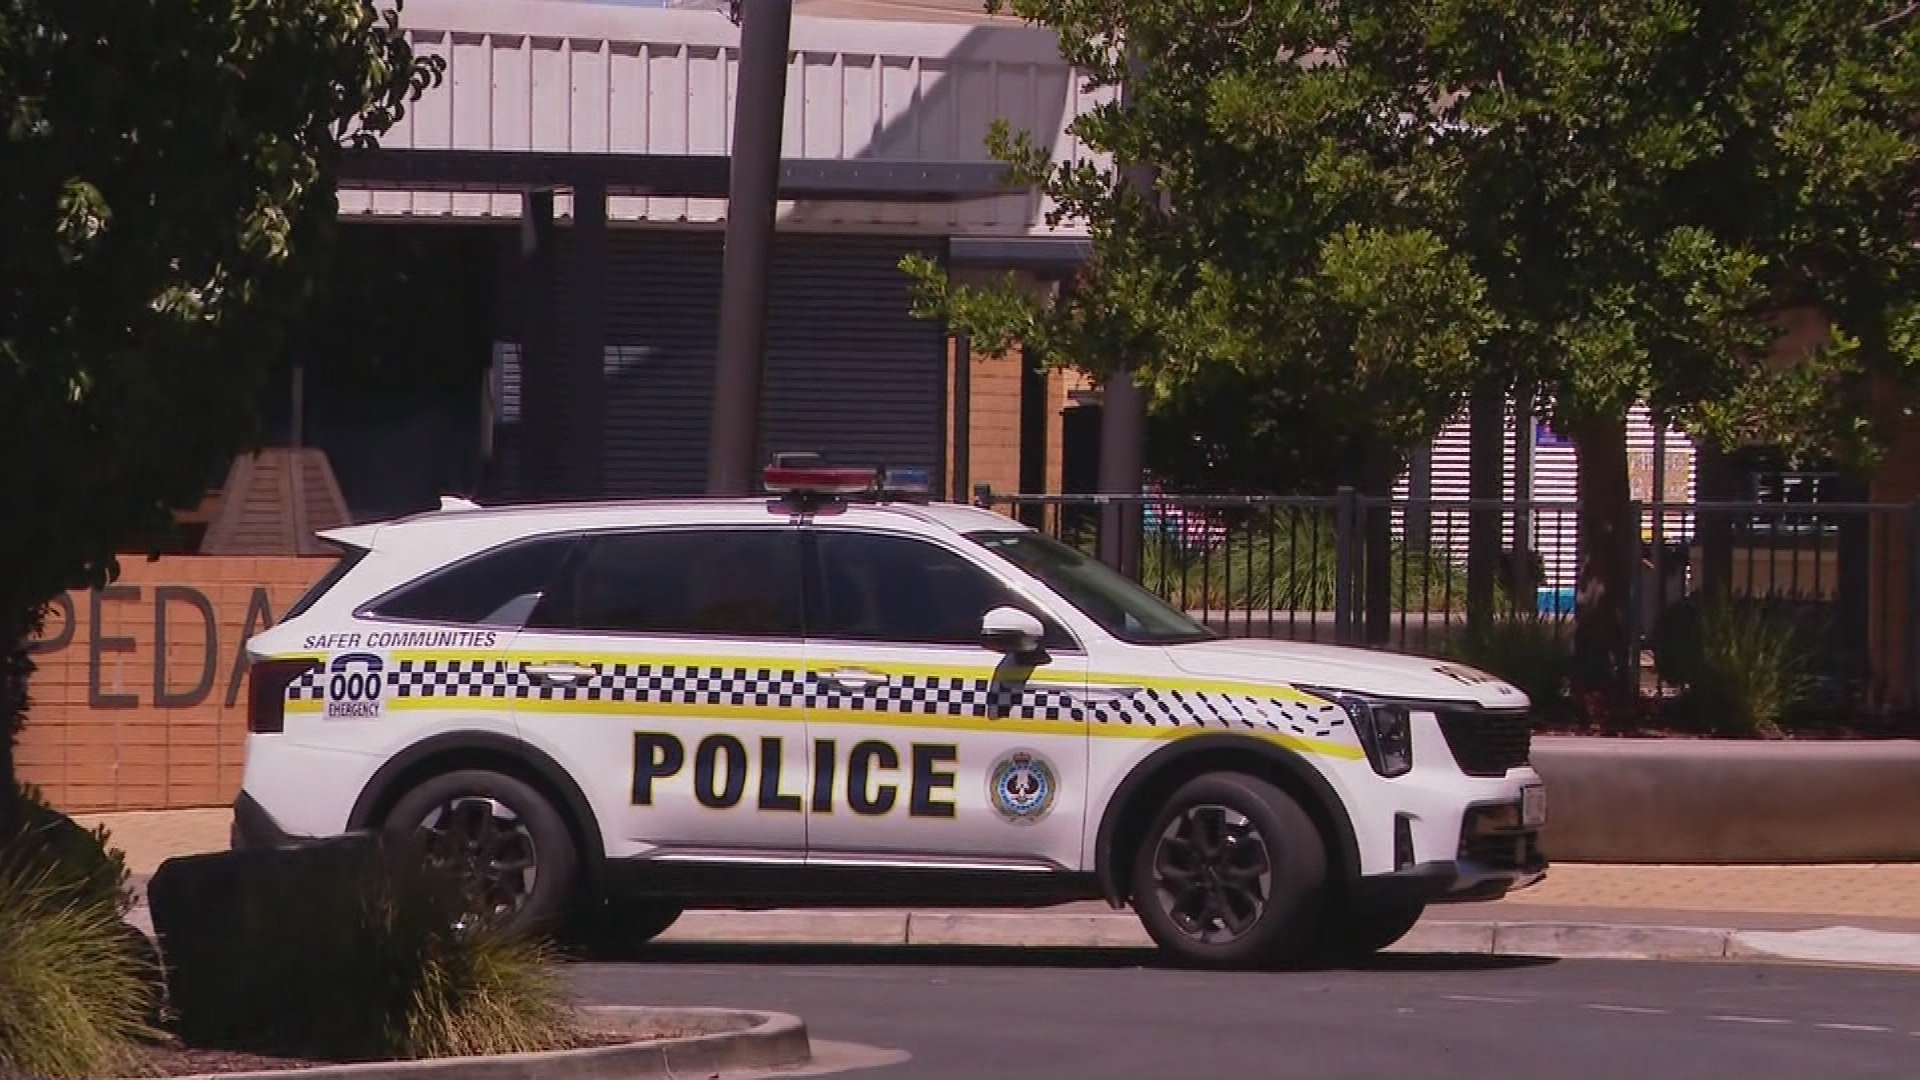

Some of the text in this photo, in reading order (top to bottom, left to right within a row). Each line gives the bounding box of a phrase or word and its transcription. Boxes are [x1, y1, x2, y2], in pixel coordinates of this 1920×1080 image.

[304, 631, 497, 649] SAFER COMMUNITIES
[330, 673, 381, 701] 000
[328, 702, 379, 718] EMERGENCY
[630, 731, 958, 817] POLICE
